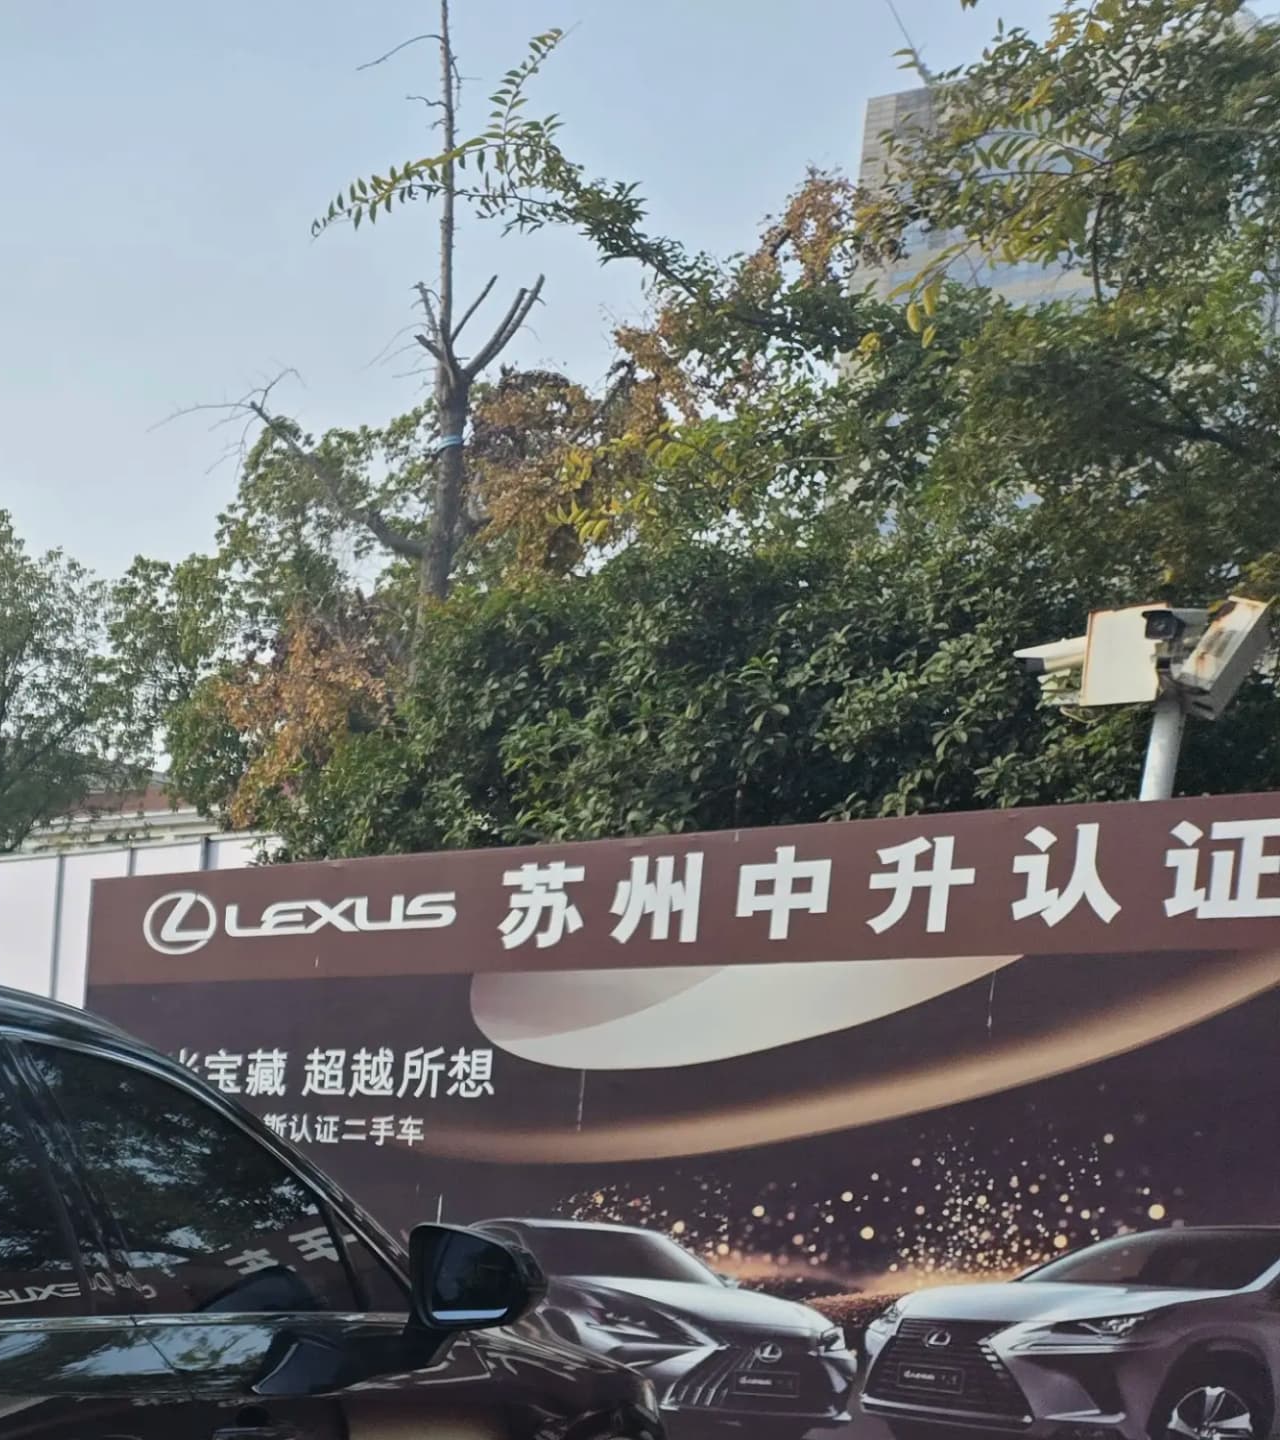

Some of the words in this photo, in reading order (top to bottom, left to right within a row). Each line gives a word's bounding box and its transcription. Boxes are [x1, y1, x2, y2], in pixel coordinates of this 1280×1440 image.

[496, 818, 1280, 949] 苏州中升认证
[225, 891, 457, 937] LEXUS
[301, 1046, 495, 1098] 超越所想
